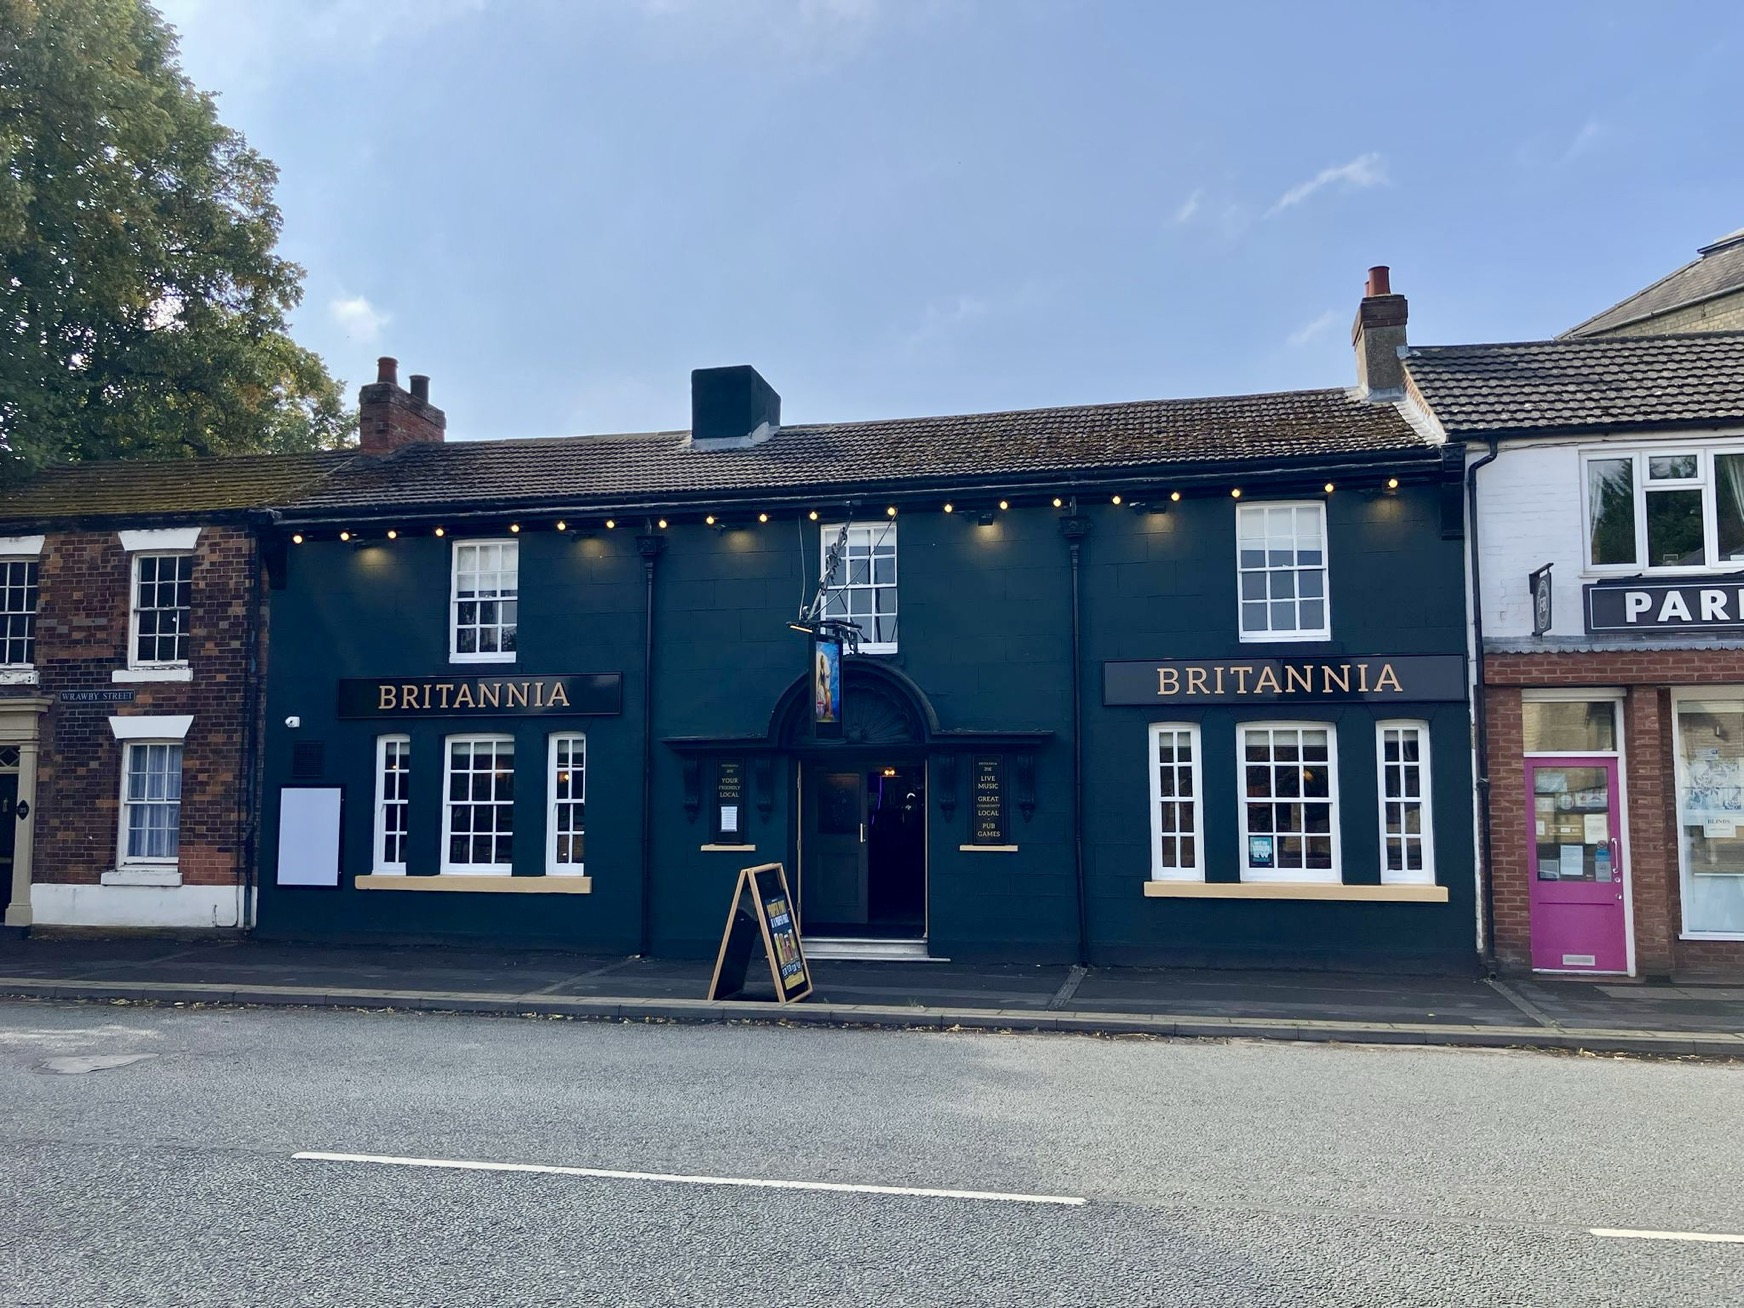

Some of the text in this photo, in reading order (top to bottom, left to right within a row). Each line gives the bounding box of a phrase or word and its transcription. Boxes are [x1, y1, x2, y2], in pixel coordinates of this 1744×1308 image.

[1625, 589, 1744, 623] PAR
[1156, 663, 1404, 696] BRITANNIA
[62, 692, 133, 700] WRAWBY STREET
[378, 681, 571, 710] BRITANNIA
